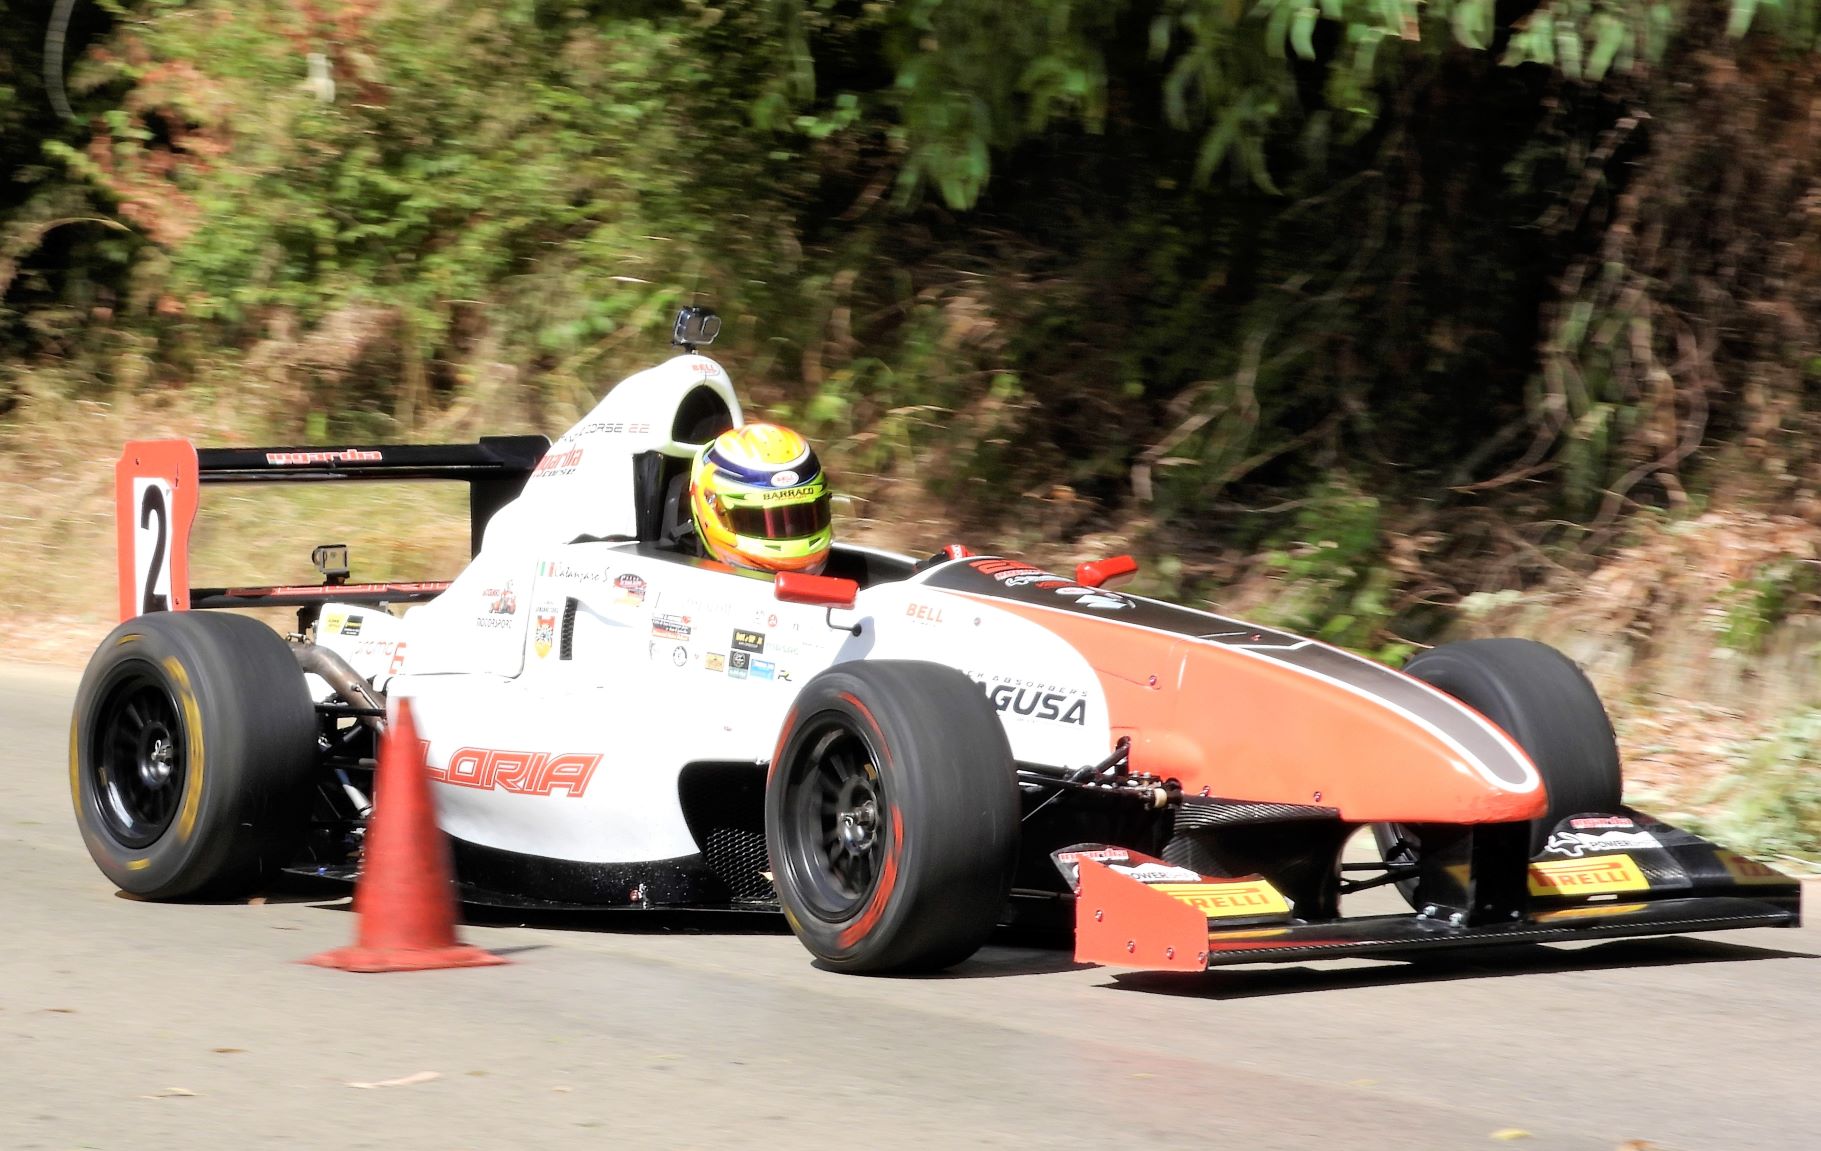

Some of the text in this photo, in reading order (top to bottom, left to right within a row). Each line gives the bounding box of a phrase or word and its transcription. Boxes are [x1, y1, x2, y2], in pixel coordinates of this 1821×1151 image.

[141, 484, 168, 614] 2
[905, 602, 943, 623] BELL
[992, 675, 1088, 697] ABSORBERS
[1130, 871, 1168, 880] OWER
